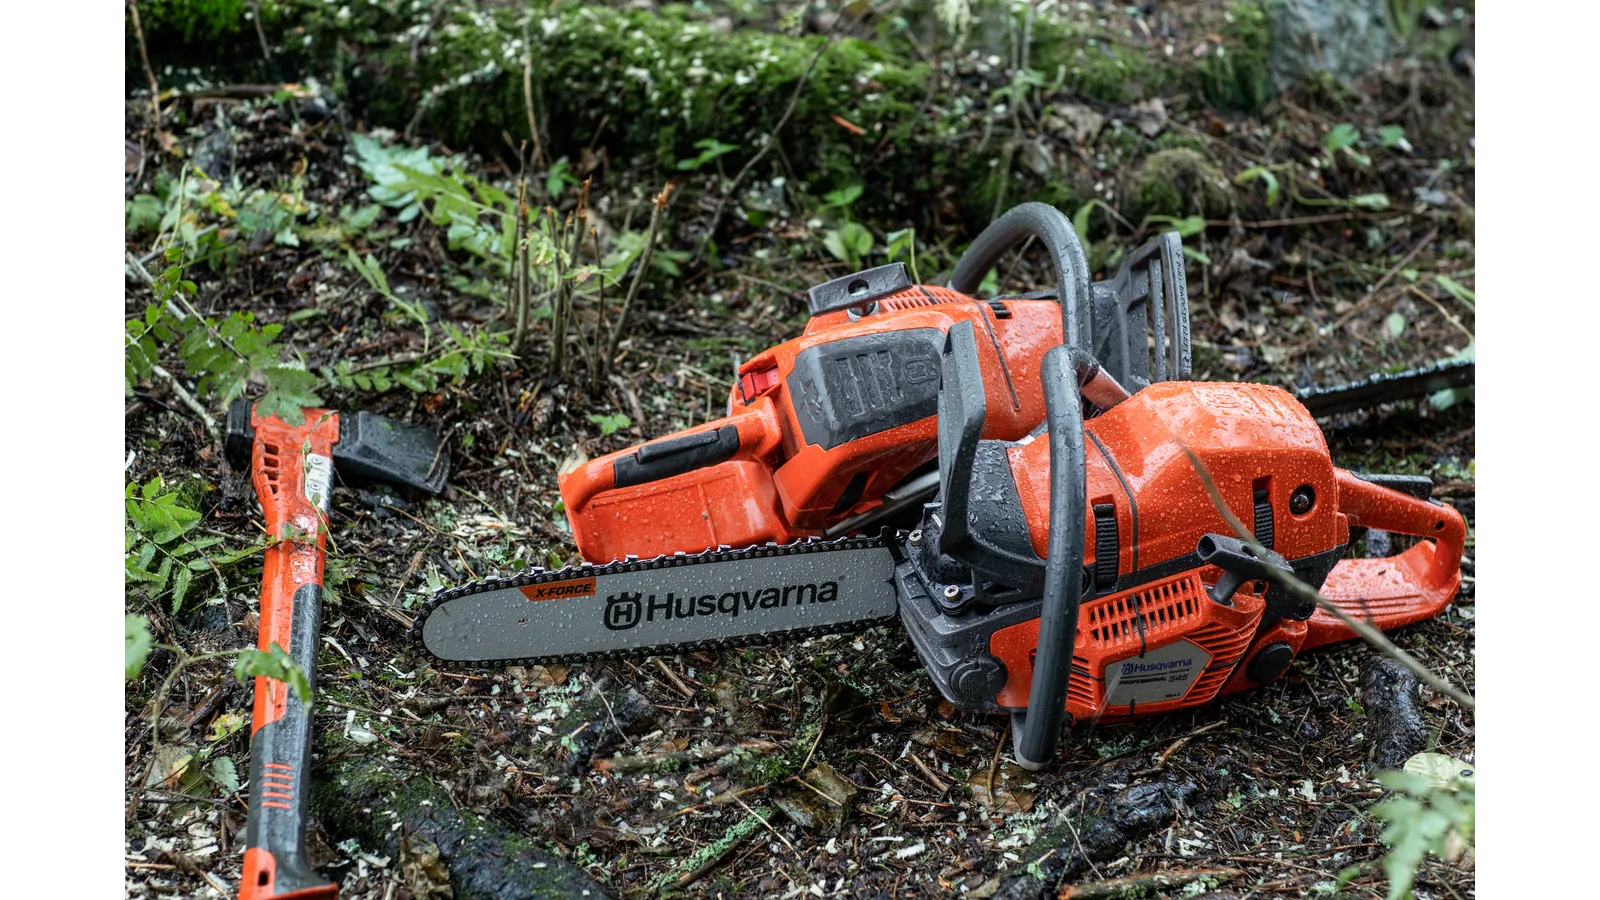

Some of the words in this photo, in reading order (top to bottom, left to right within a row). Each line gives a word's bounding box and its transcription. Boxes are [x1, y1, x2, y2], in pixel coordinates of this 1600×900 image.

[535, 583, 593, 598] X-FORCE
[646, 580, 839, 622] Husqvarna
[1134, 659, 1192, 672] Husqvarna
[1119, 676, 1167, 685] PROFESSIONAL
[1168, 674, 1189, 683] 545
